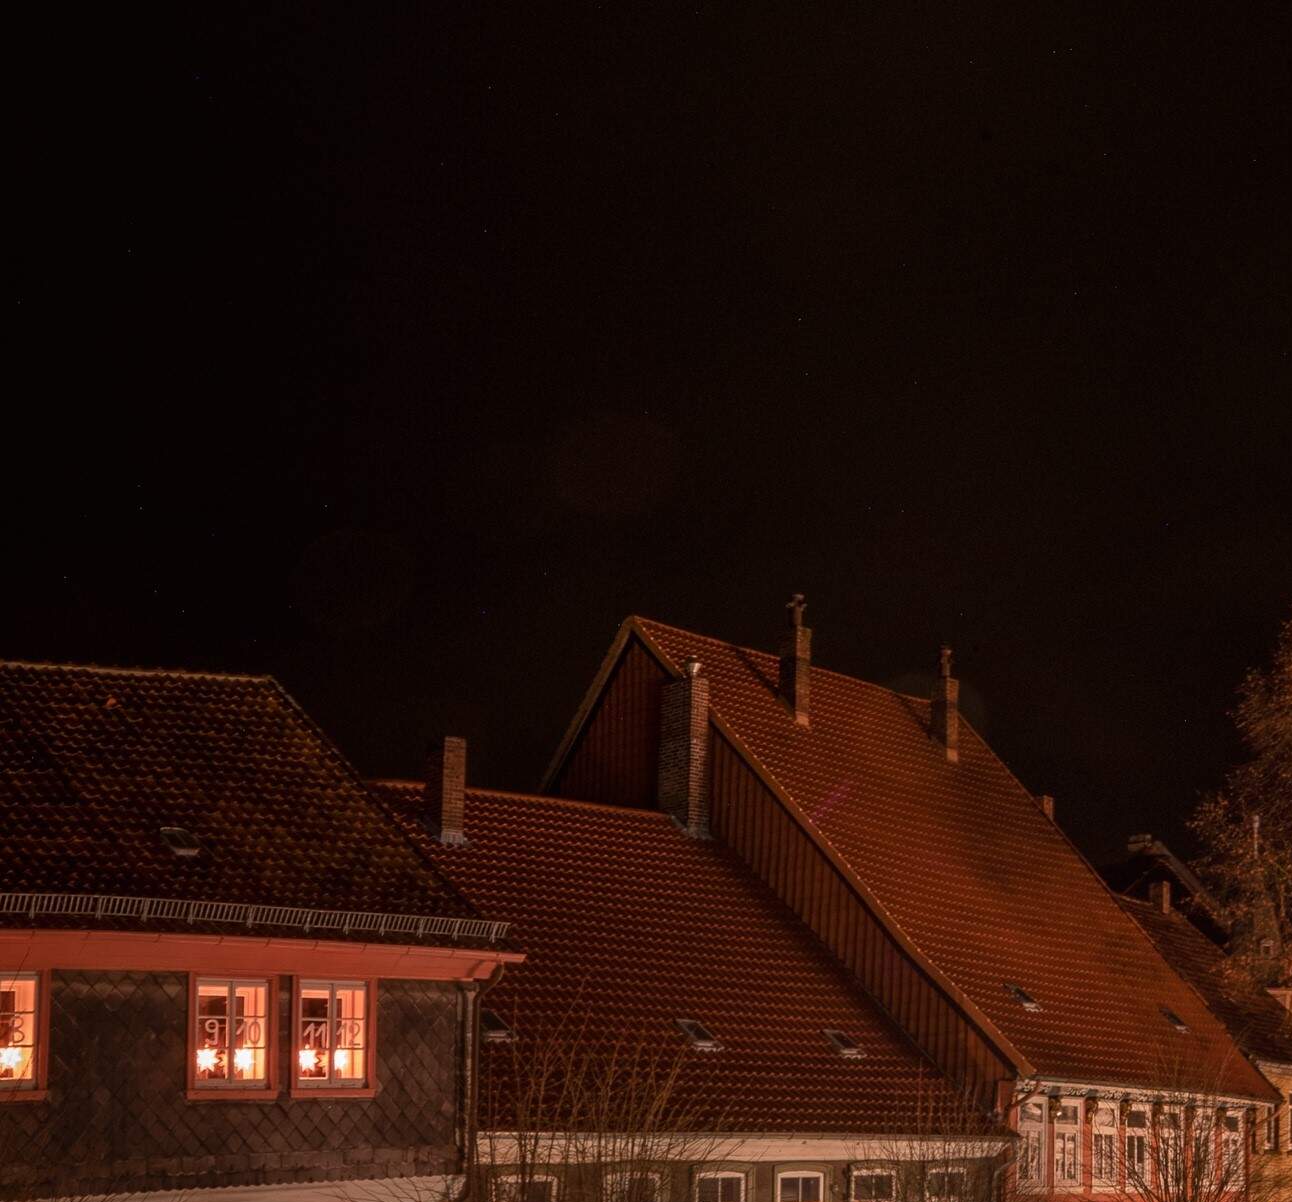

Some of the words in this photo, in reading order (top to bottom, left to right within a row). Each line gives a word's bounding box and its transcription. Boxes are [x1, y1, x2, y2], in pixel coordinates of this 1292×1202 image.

[204, 1019, 220, 1046] 9
[236, 1019, 261, 1043] 10
[303, 1021, 328, 1048] 11
[336, 1021, 362, 1047] 12
